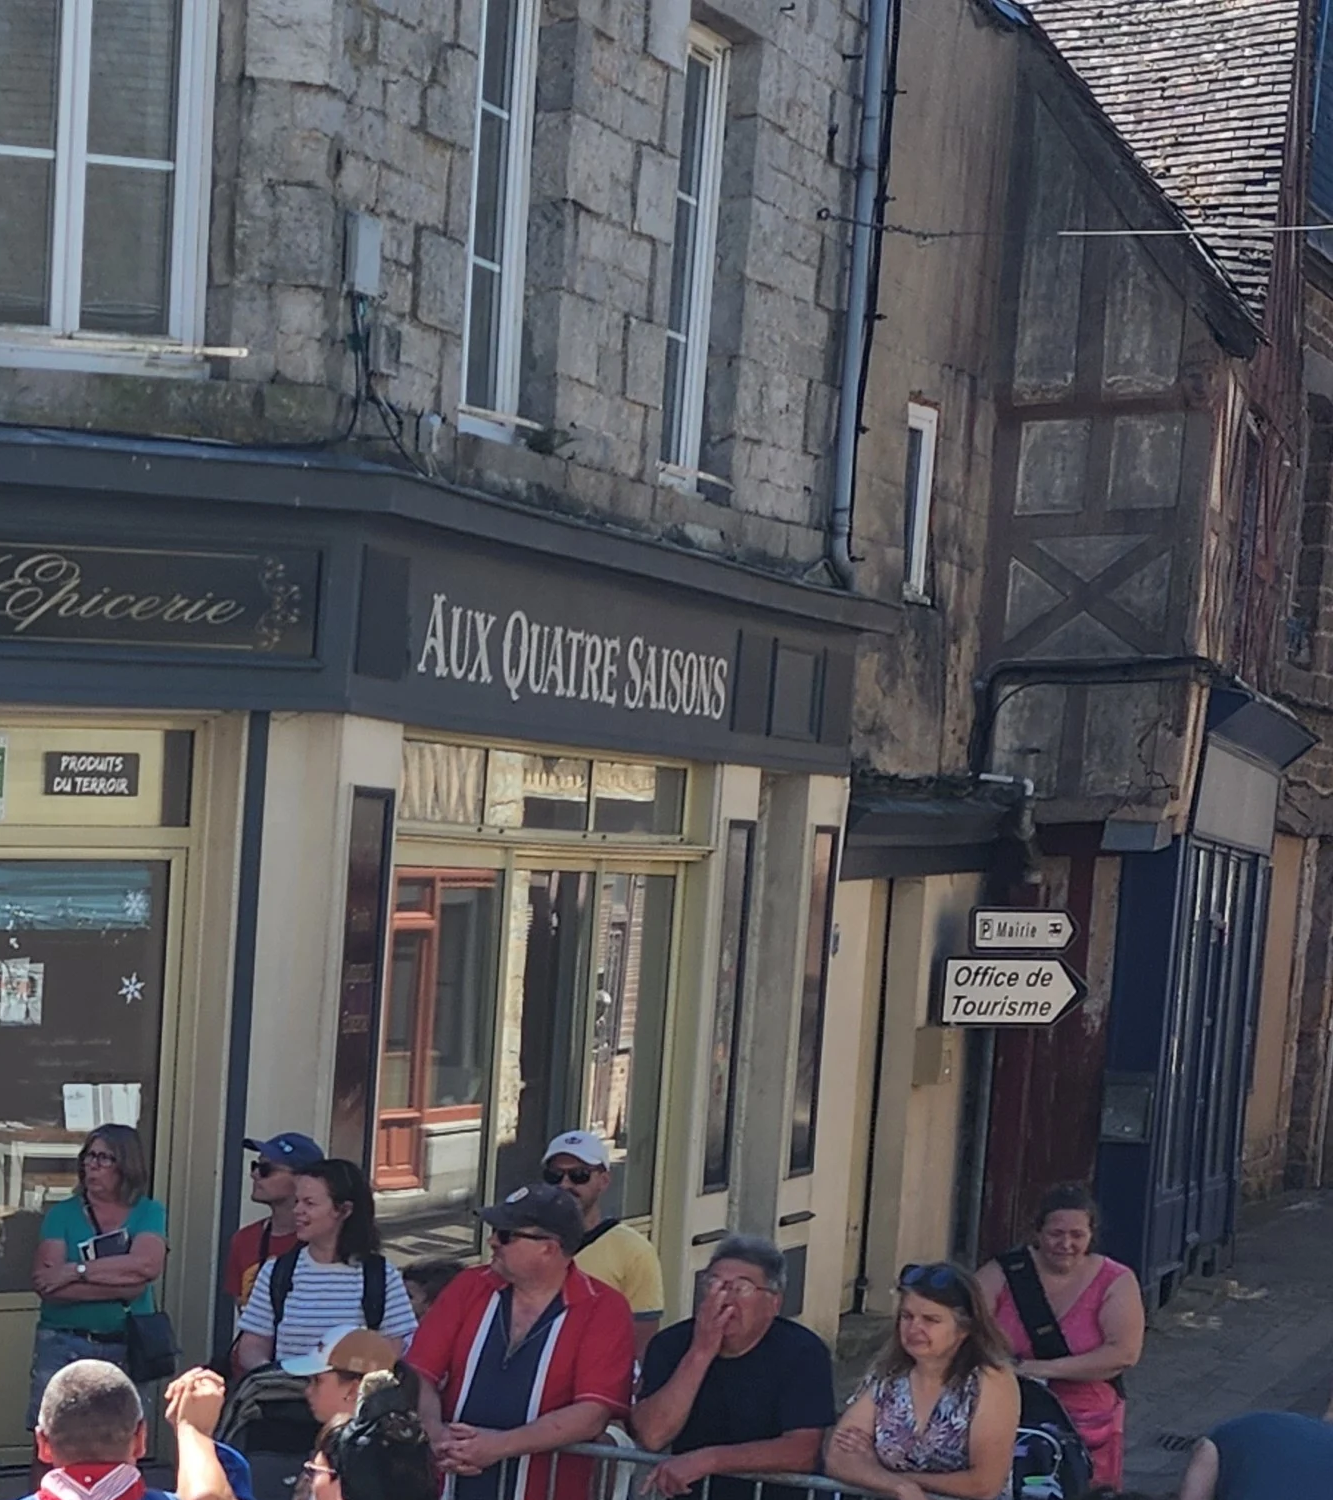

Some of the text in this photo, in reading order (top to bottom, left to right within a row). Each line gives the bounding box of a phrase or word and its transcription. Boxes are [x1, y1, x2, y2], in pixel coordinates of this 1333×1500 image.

[417, 593, 728, 720] AUX QUATRE SAISONS
[60, 755, 124, 773] PRODUITS
[53, 777, 129, 795] DU TERROIR
[996, 922, 1038, 938] Mairie
[954, 965, 1053, 988] Office de
[951, 995, 1052, 1017] Tourisme
